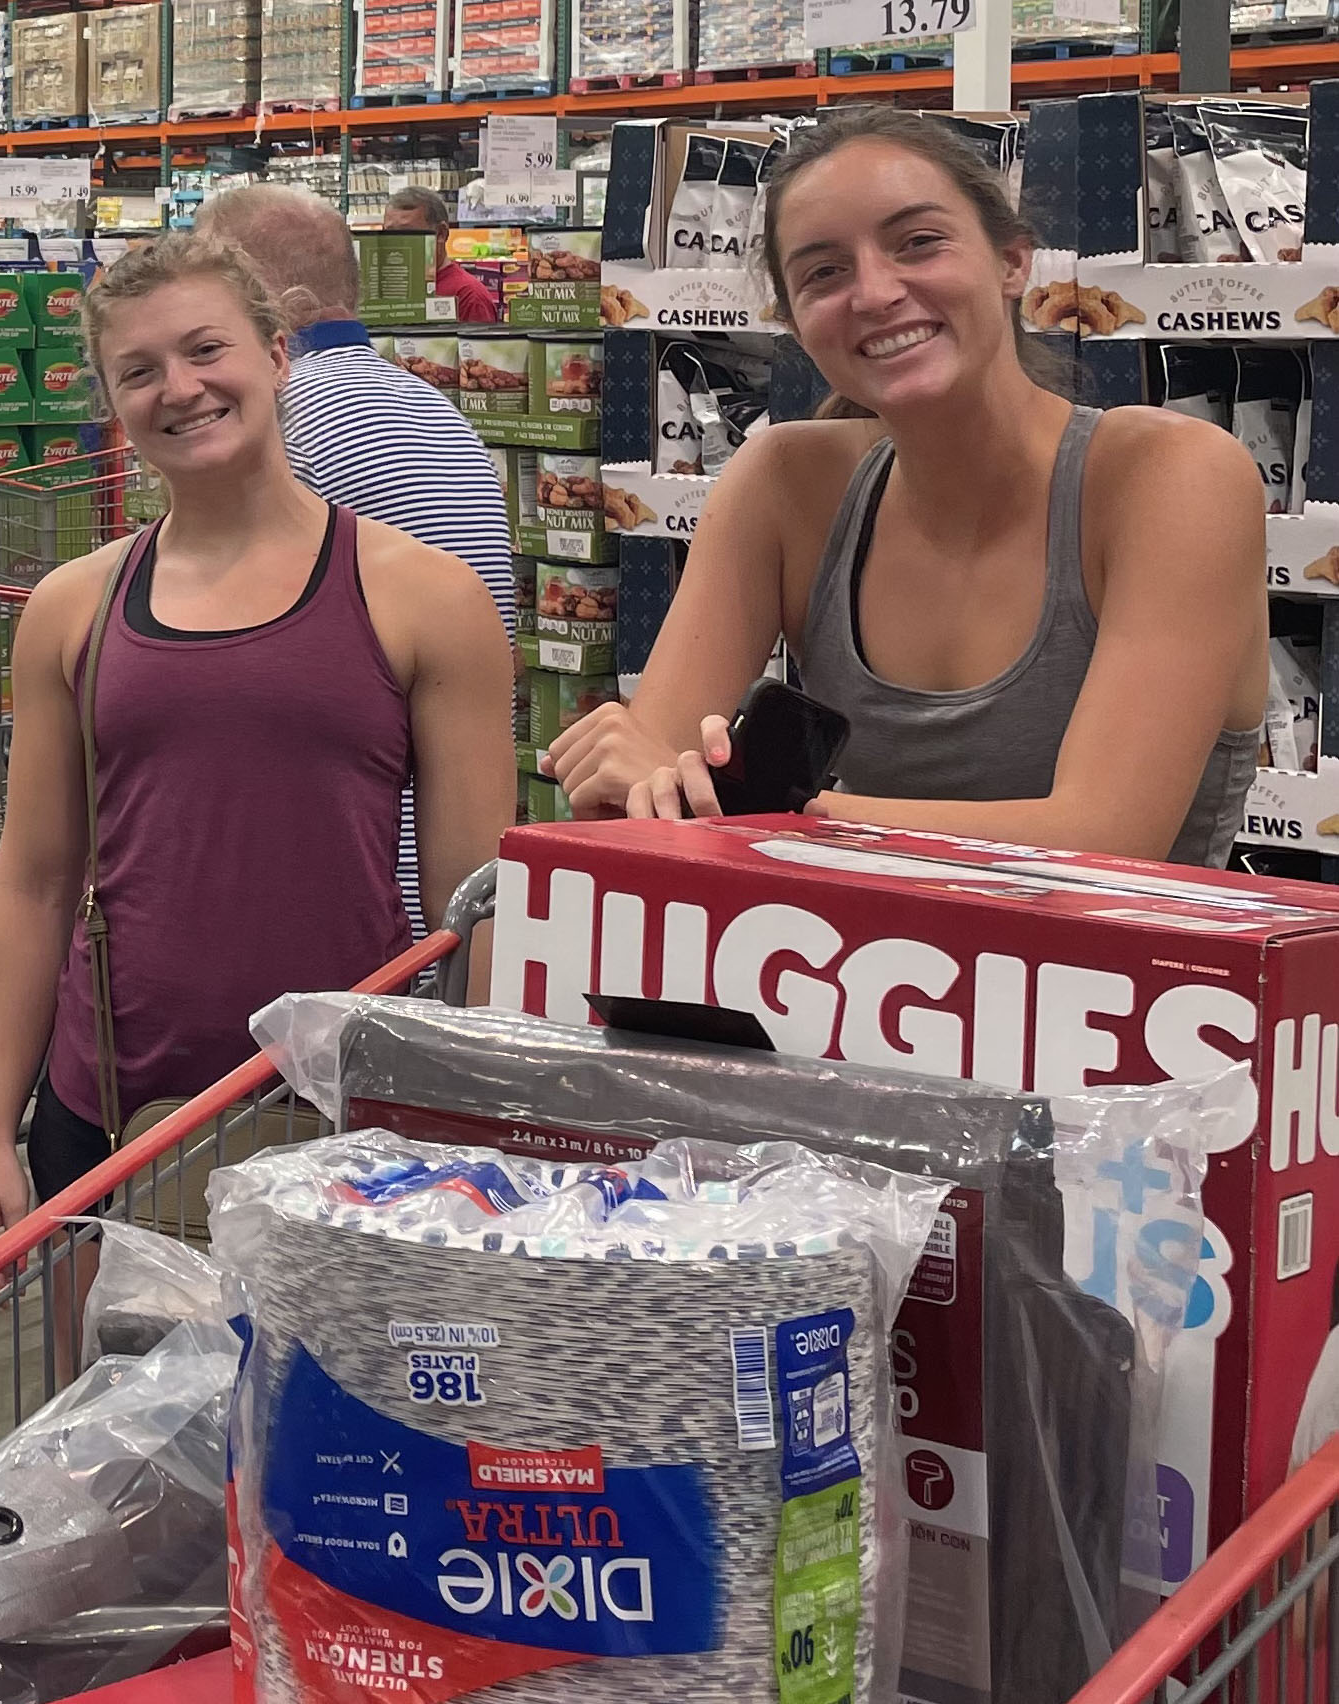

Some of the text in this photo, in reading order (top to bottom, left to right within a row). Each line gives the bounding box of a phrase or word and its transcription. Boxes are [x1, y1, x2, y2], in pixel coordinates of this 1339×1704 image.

[881, 0, 970, 36] 13.79
[524, 152, 553, 169] 5.99
[9, 185, 38, 197] 15.99
[61, 187, 89, 198] 21.49
[505, 193, 530, 205] 16.99
[551, 194, 576, 205] 21.99
[534, 288, 576, 299] NUT MIX
[1169, 277, 1265, 303] BUTTER TOFFEE
[541, 311, 581, 323] NUT MIX
[657, 309, 750, 327] CASHEWS
[1157, 310, 1281, 331] CASHEWS
[469, 399, 488, 411] MIX
[546, 516, 595, 530] NUT MIX
[570, 628, 596, 641] NUT
[490, 858, 1261, 1152] HUGGIES
[512, 1130, 531, 1143] 2.4
[533, 1135, 547, 1146] m
[548, 1137, 557, 1147] x
[558, 1137, 567, 1149] 3
[569, 1140, 583, 1152] m
[593, 1142, 602, 1154] 8
[604, 1143, 616, 1157] ft
[627, 1147, 643, 1160] 10
[390, 1323, 466, 1345] IN (25.5 cm)
[410, 1354, 477, 1371] PLATES
[410, 1370, 484, 1402] 186
[334, 1633, 394, 1649] WHATEVER
[399, 1640, 423, 1651] FOR
[304, 1639, 445, 1680] STRENGTH
[332, 1668, 408, 1692] ULTIMATE
